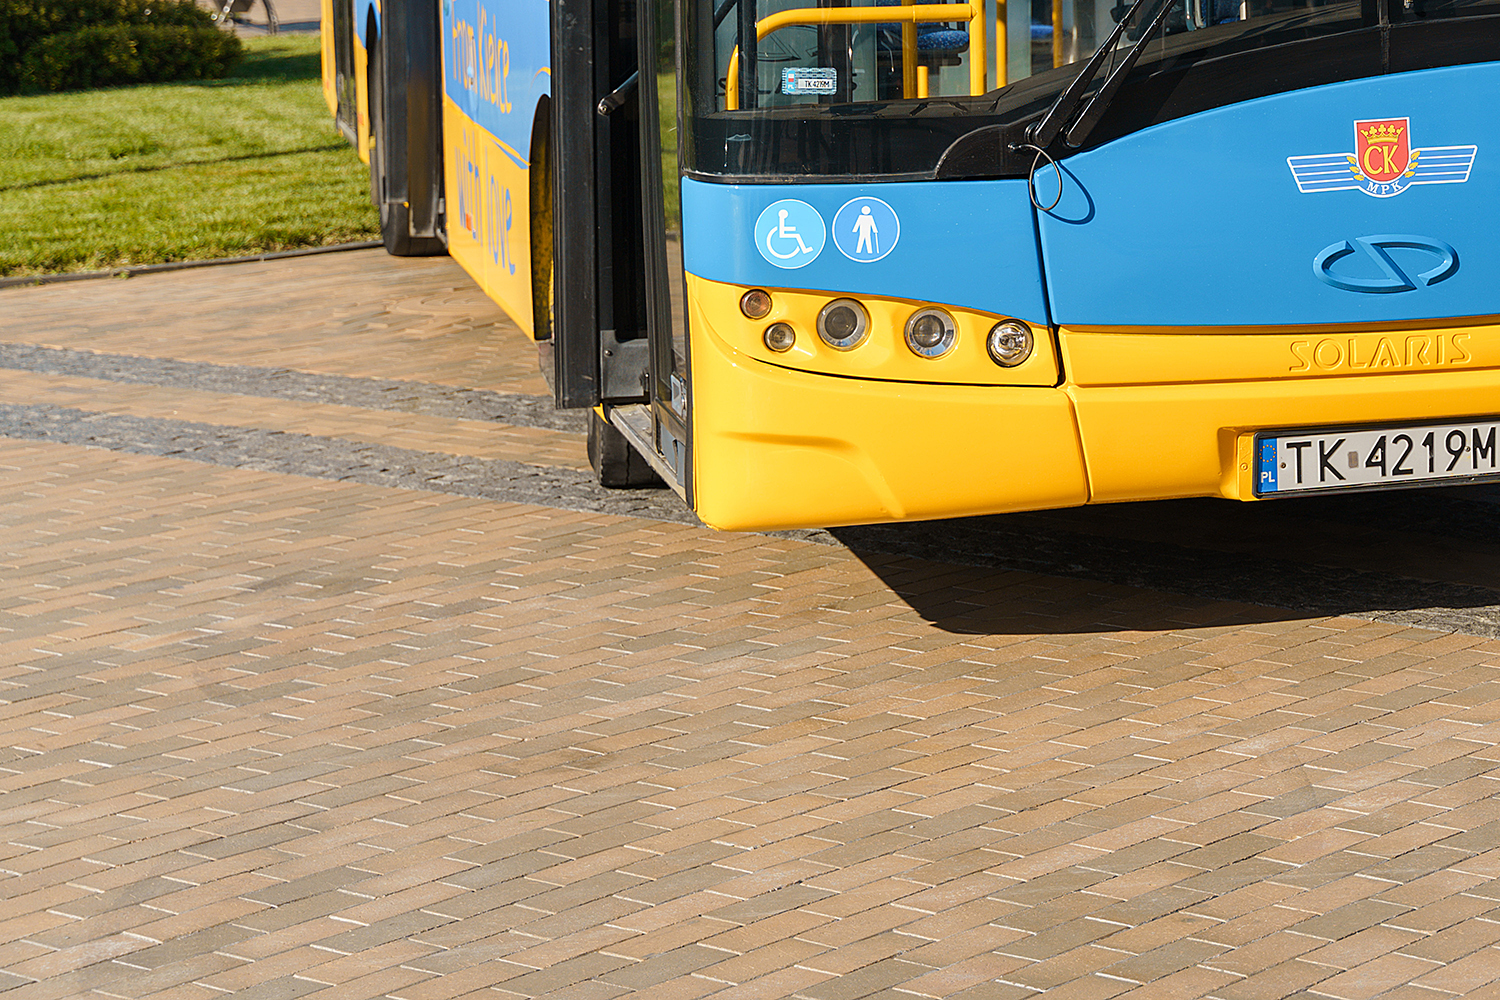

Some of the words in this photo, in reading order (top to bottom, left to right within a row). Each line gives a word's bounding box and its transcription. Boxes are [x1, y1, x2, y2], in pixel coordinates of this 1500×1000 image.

[477, 0, 513, 115] Kielce
[1363, 144, 1400, 175] CK
[484, 145, 516, 276] love
[1366, 179, 1404, 195] MPK
[1289, 333, 1472, 373] SOLARIS
[1260, 472, 1276, 484] PL
[1286, 438, 1347, 484] TK
[1364, 426, 1497, 478] 4219M
